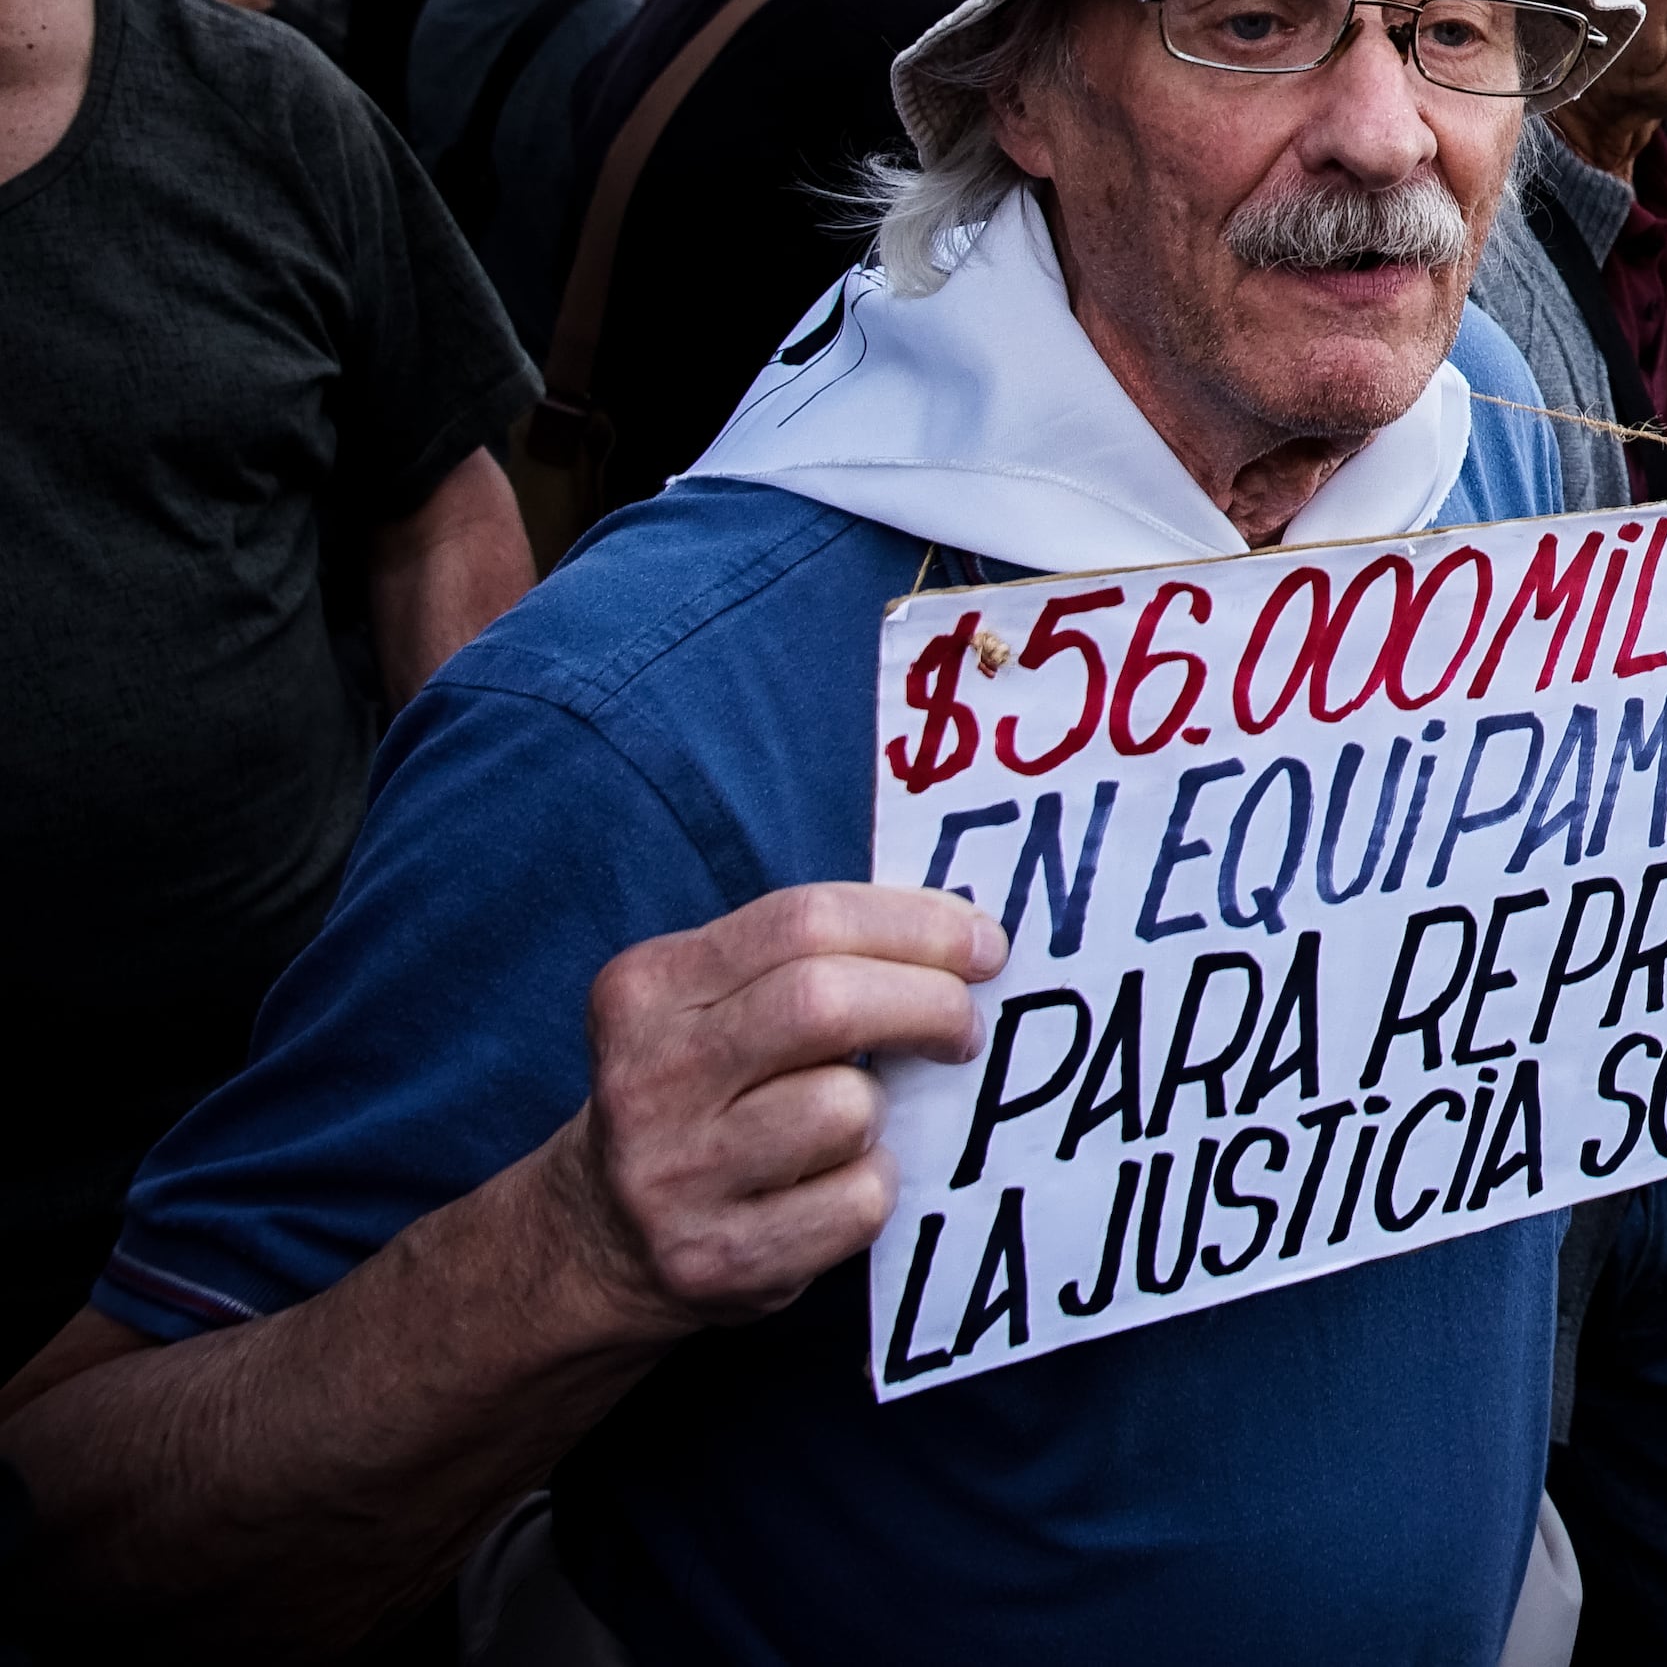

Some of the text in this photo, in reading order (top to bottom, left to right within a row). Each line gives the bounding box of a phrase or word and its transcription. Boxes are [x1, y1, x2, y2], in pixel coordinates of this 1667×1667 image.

[922, 780, 1115, 959] EN
[950, 932, 1320, 1189] PARA
[883, 1186, 1030, 1386] LA
